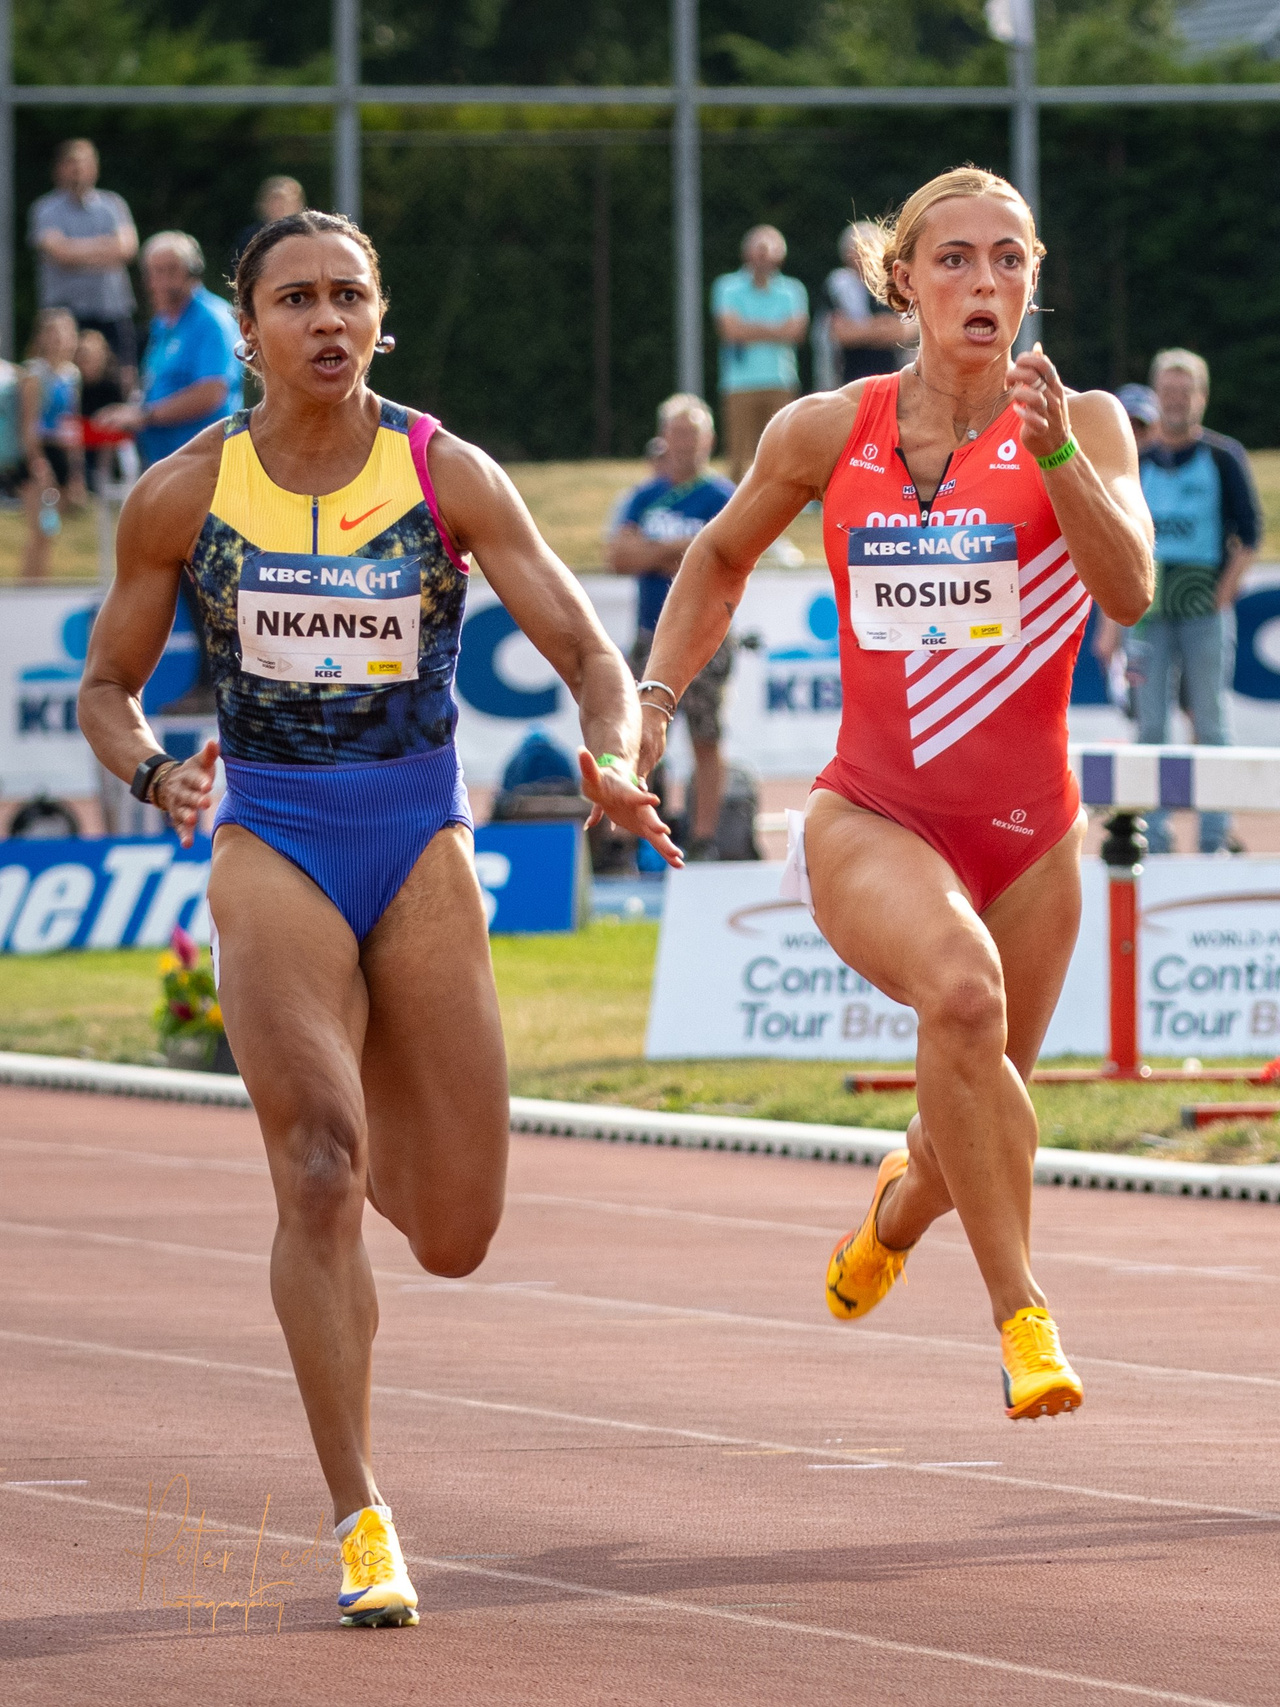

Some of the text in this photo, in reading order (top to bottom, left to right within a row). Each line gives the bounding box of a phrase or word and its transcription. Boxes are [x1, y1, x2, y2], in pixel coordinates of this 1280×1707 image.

[874, 579, 993, 608] ROSIUS
[256, 609, 403, 640] NKANSA
[921, 637, 947, 645] KBC
[314, 670, 343, 678] KBC
[767, 673, 843, 712] KB
[740, 1001, 918, 1042] Tour Bro
[1148, 999, 1243, 1040] Tour
